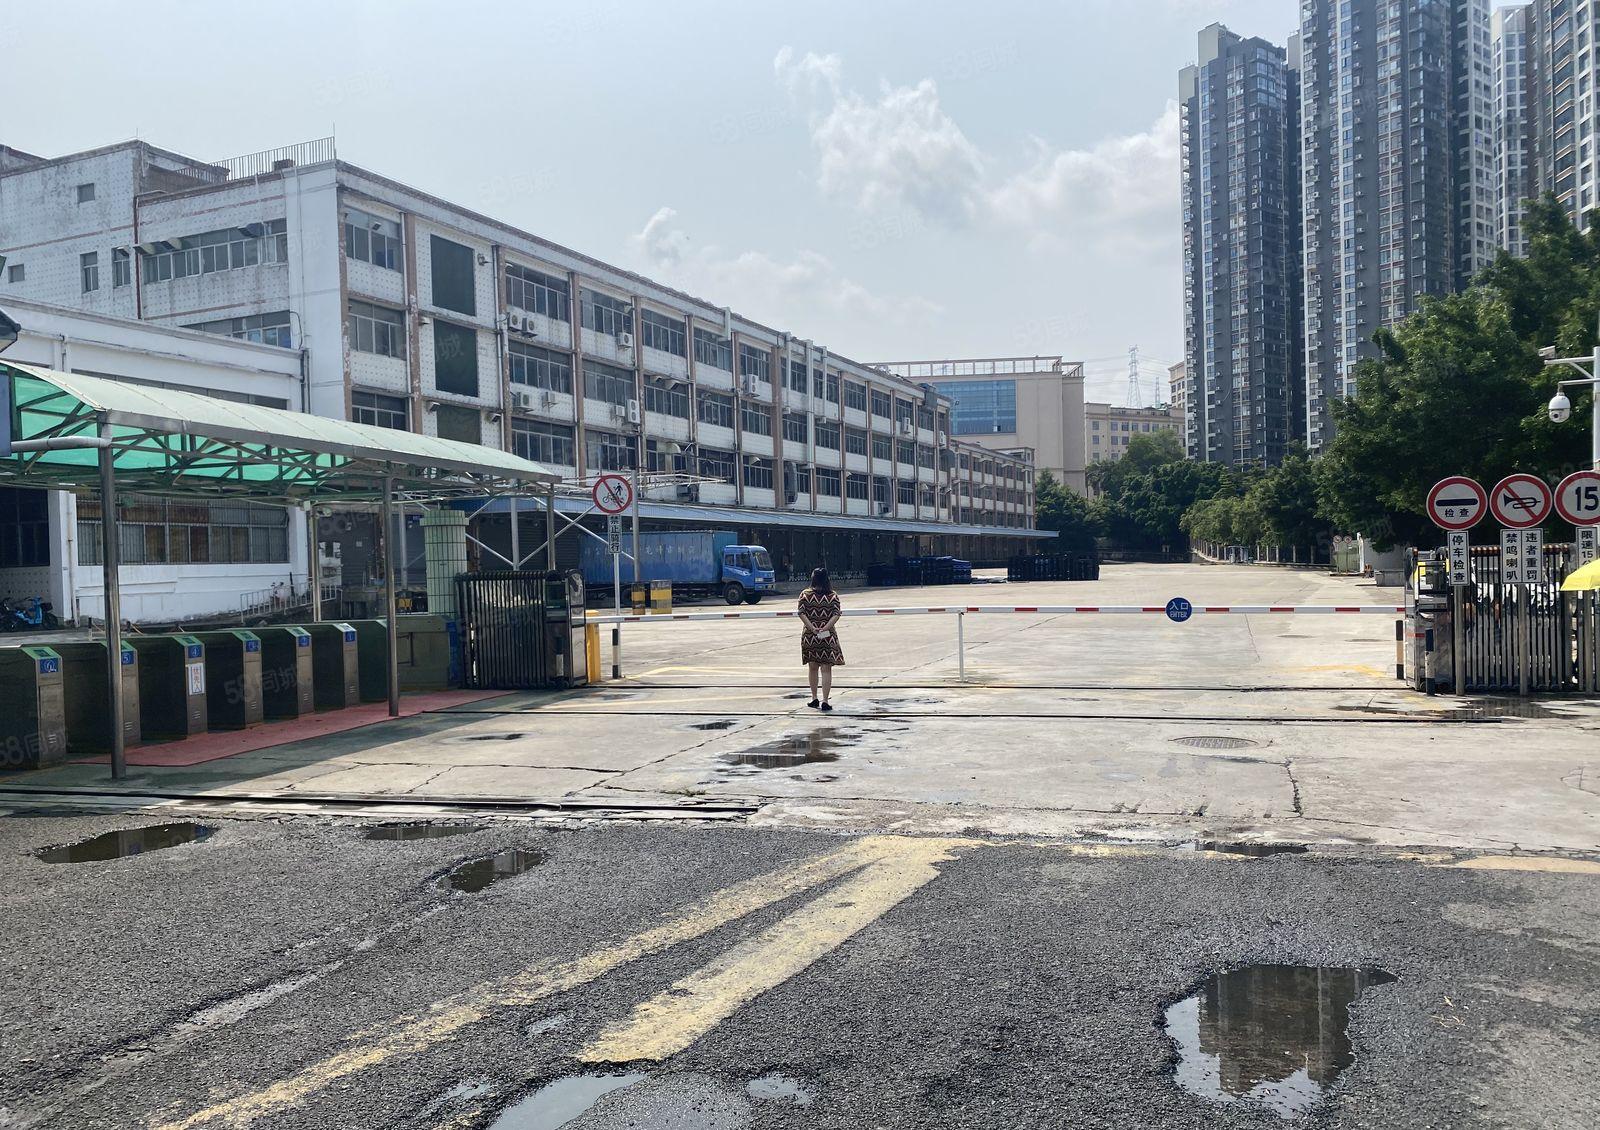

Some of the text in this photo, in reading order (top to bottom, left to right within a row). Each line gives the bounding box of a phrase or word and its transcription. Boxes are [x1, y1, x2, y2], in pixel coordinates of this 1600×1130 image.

[1445, 508, 1469, 518] 检查
[1575, 486, 1599, 511] 15
[610, 515, 619, 551] 禁止骑行
[1452, 535, 1465, 582] 停车检查
[1506, 533, 1518, 581] 禁鸣喇叭
[1525, 532, 1538, 581] 违者重罚
[1170, 601, 1188, 610] 入口
